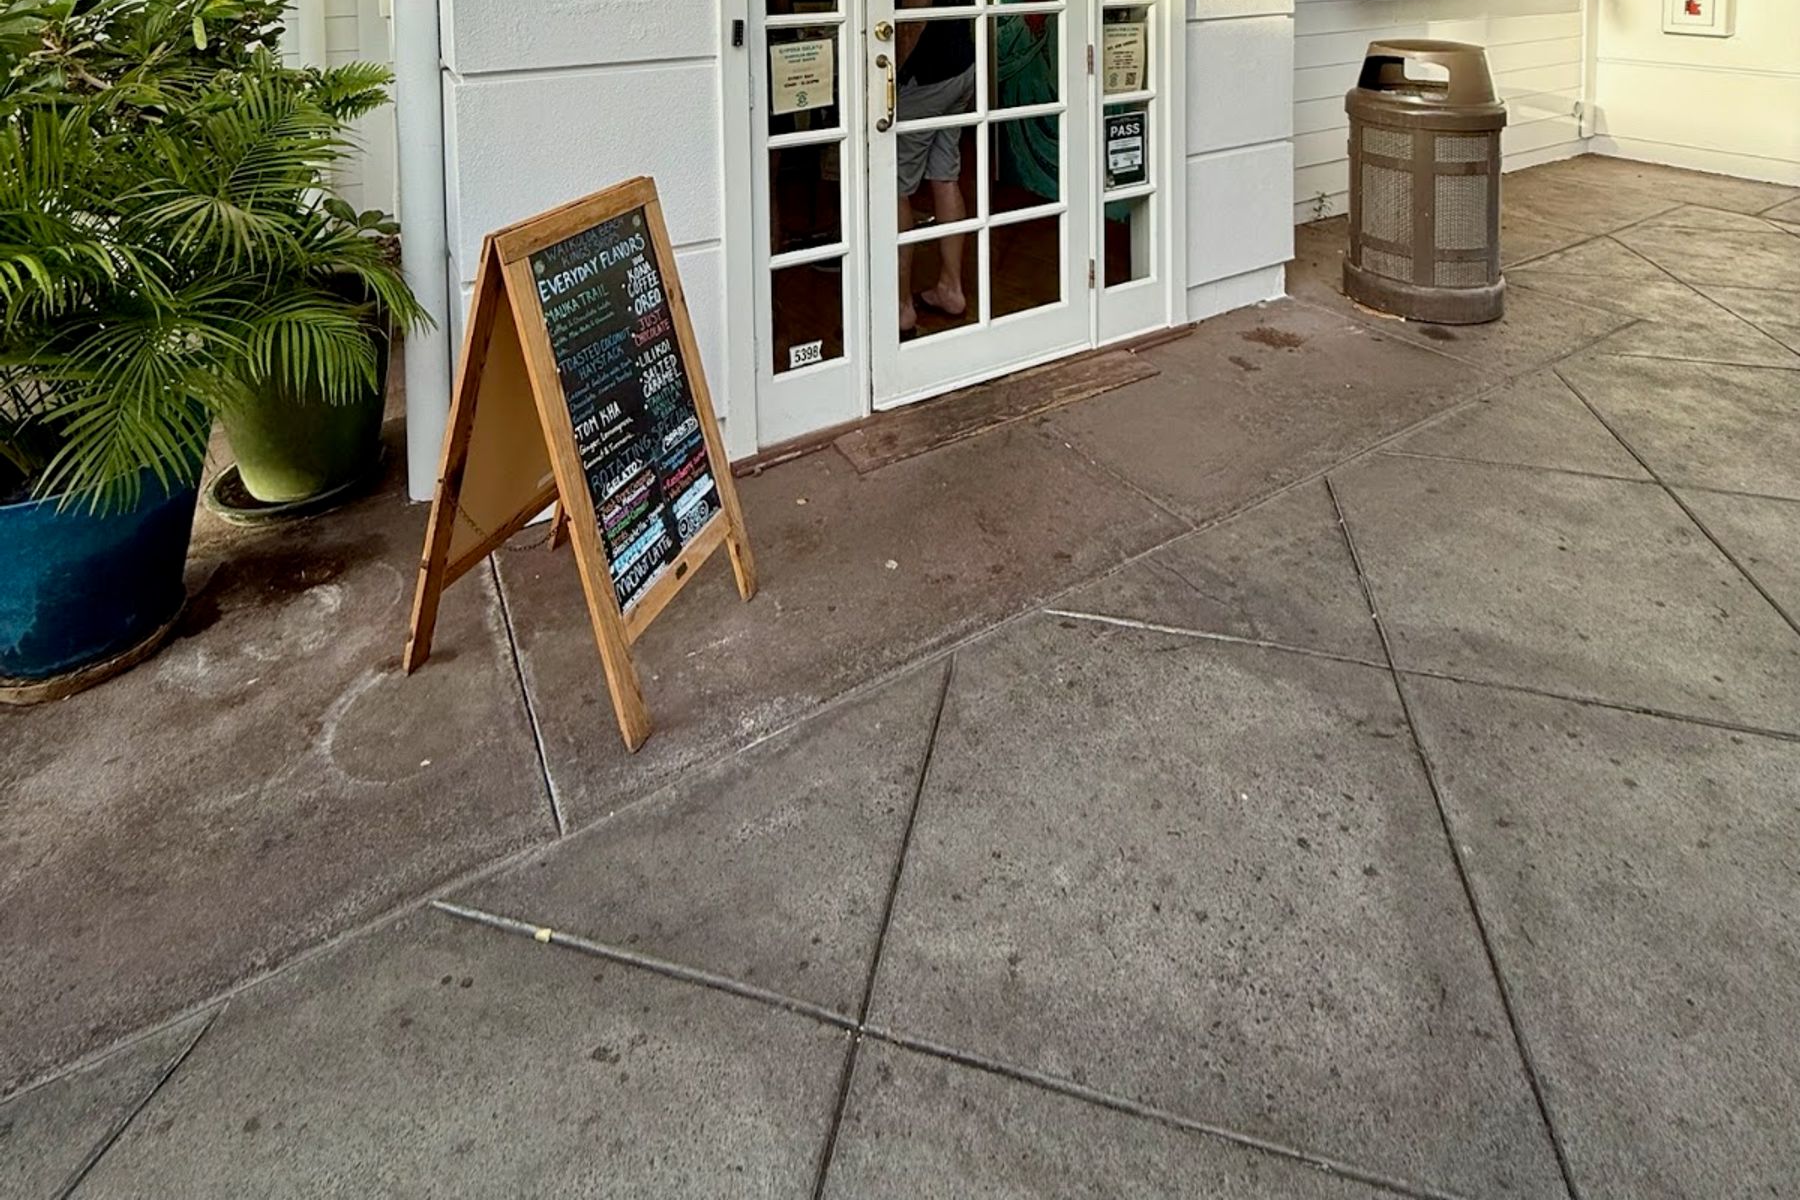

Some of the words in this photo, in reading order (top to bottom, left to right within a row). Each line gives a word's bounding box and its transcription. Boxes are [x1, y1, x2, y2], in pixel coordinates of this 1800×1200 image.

[1110, 123, 1141, 138] PASS
[538, 256, 598, 303] EVERYDAY
[599, 233, 645, 270] FLAVORS
[577, 284, 609, 306] TRAIL
[627, 269, 659, 298] COFFEE
[634, 287, 662, 316] OREO
[638, 308, 661, 331] JUST
[559, 341, 600, 376] TOASTED
[578, 346, 625, 381] HAYSTACK
[642, 354, 677, 384] SALTED
[794, 345, 819, 363] 5398
[575, 415, 599, 440] TOM
[599, 401, 621, 427] KHA
[592, 434, 651, 493] ROTATING
[647, 535, 672, 566] LATTE
